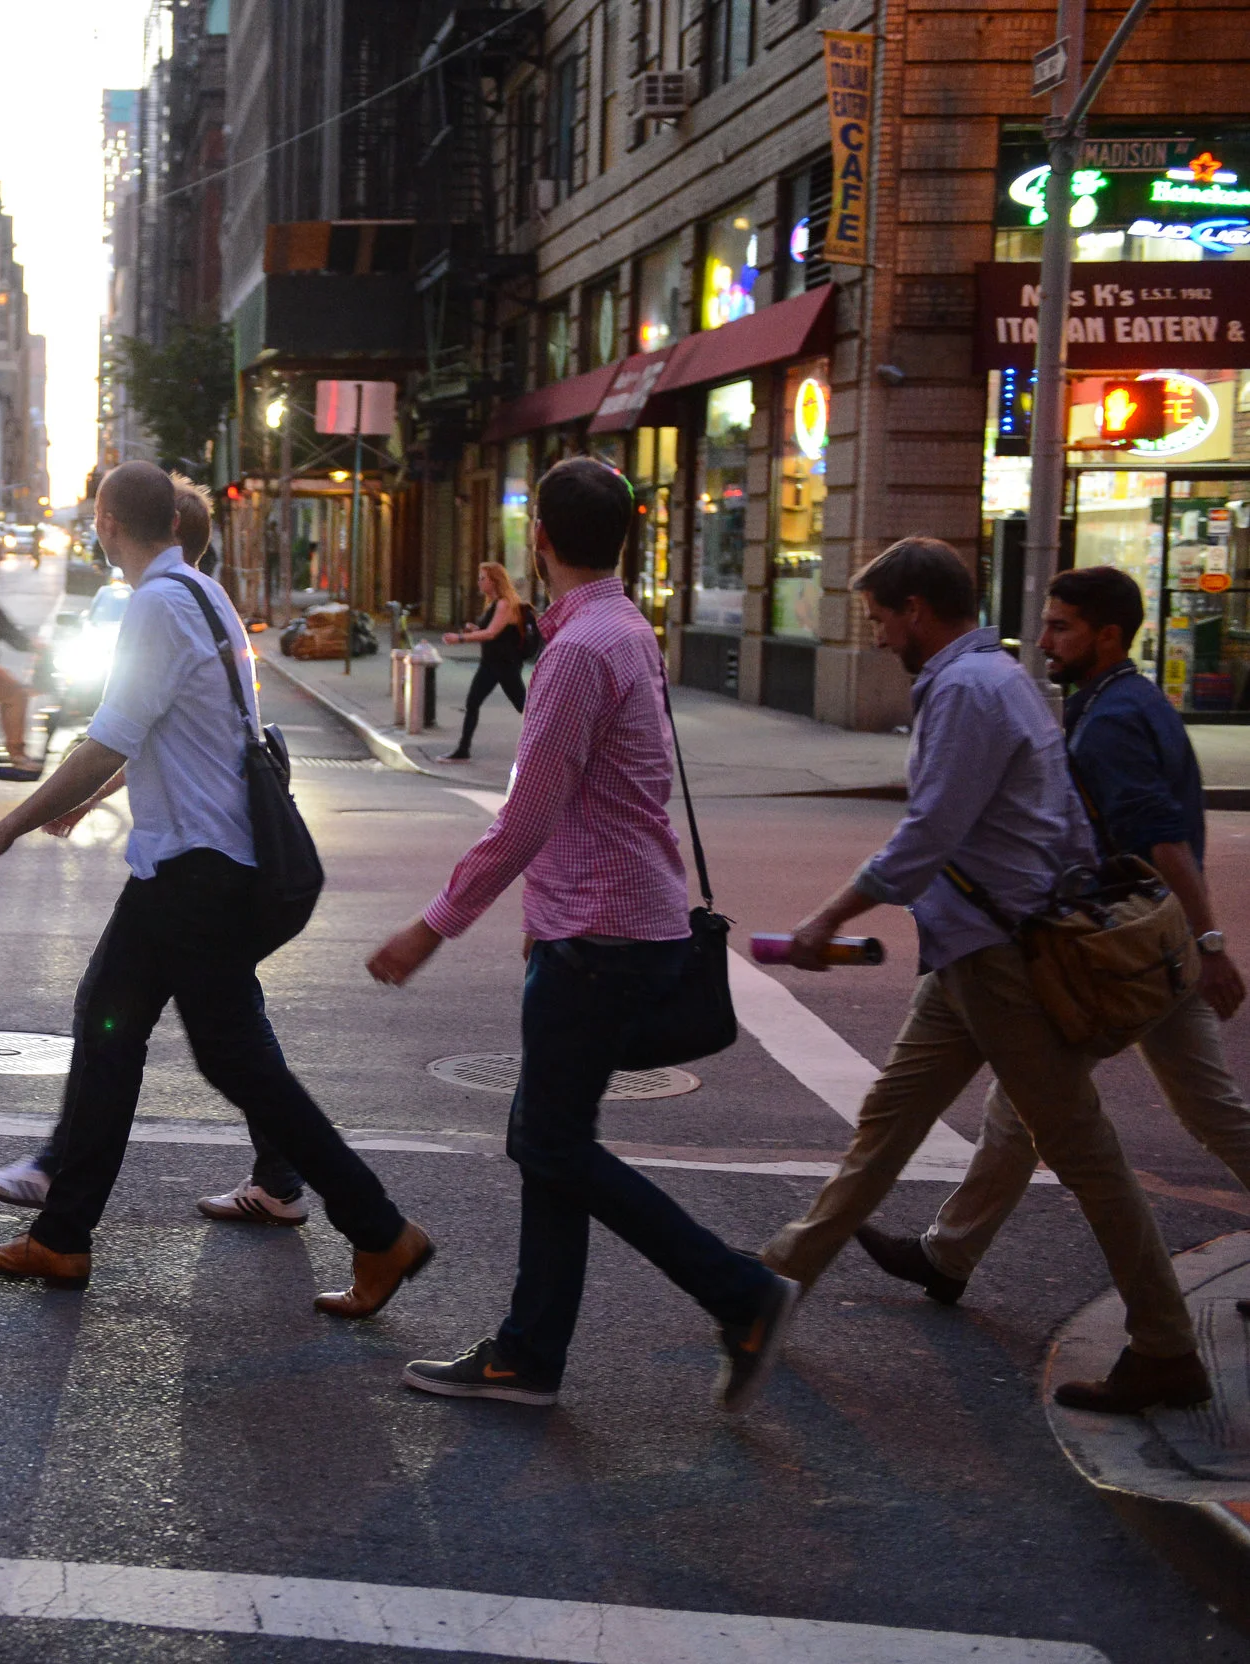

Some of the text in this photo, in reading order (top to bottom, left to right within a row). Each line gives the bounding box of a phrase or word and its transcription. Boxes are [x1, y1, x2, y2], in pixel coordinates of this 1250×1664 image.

[1085, 142, 1167, 167] MADISON
[837, 122, 864, 242] CAFE
[1151, 181, 1250, 206] Heineken
[1127, 219, 1193, 240] BUD
[1020, 284, 1086, 307] Ms
[1094, 284, 1135, 307] K's
[996, 316, 1245, 343] ITAAN EATERY &
